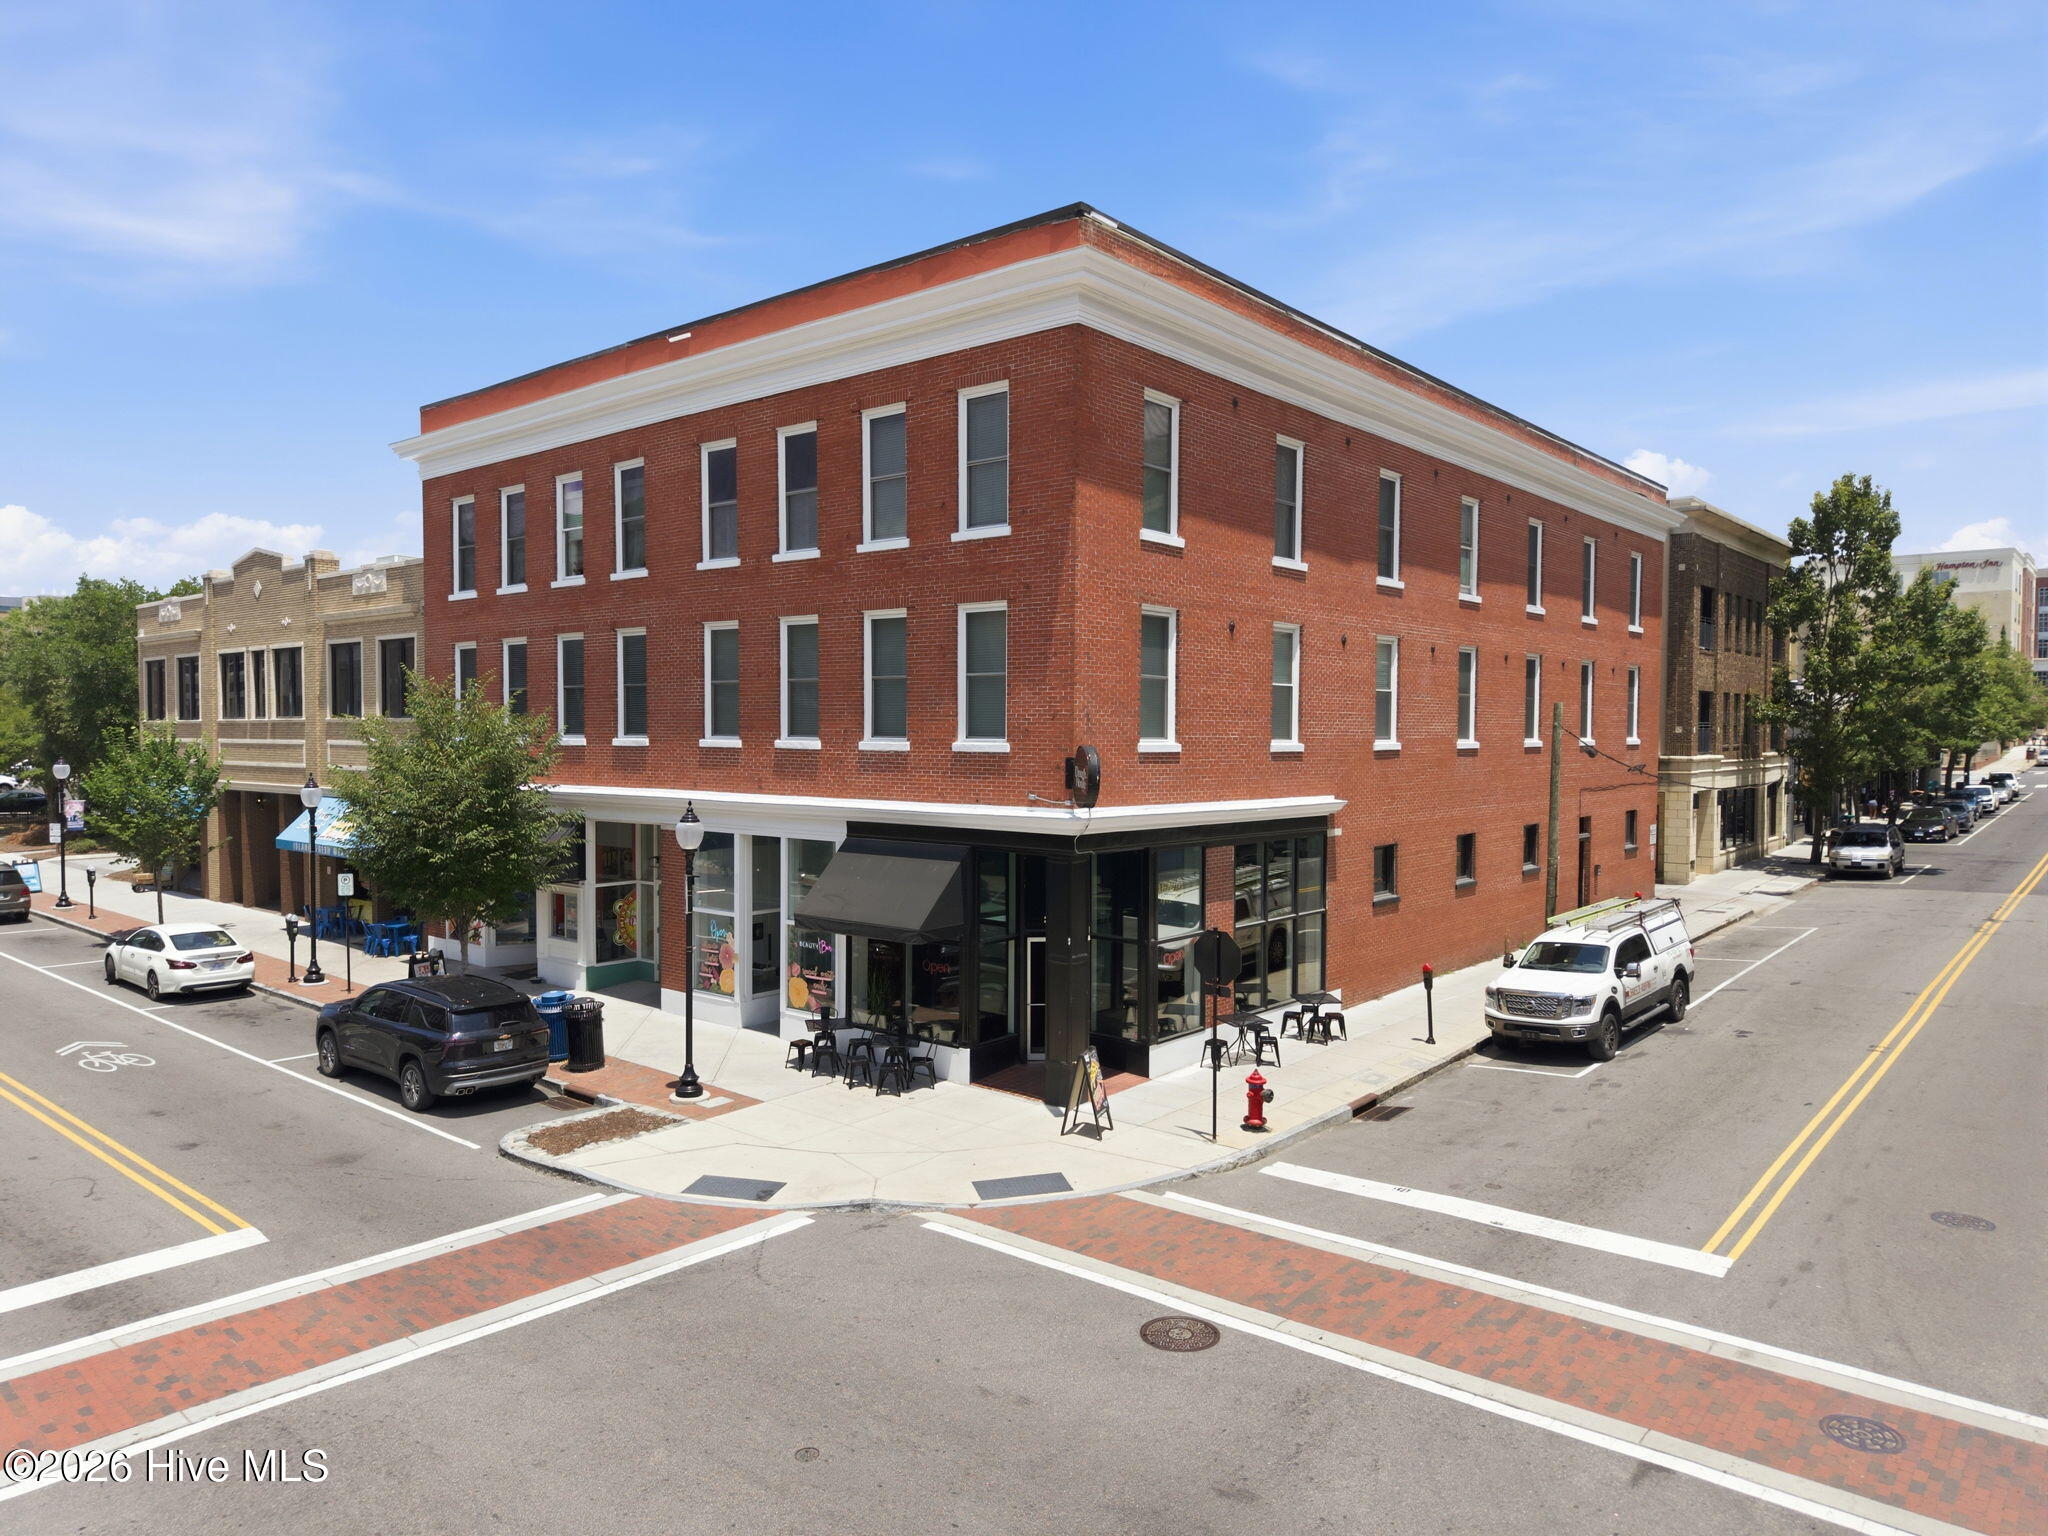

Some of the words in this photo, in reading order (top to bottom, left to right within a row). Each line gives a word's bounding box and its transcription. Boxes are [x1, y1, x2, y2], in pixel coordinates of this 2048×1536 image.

[1936, 562, 1977, 571] Hampton
[1980, 559, 2003, 569] Inn
[799, 940, 819, 950] BEAUTY
[922, 960, 951, 975] Open
